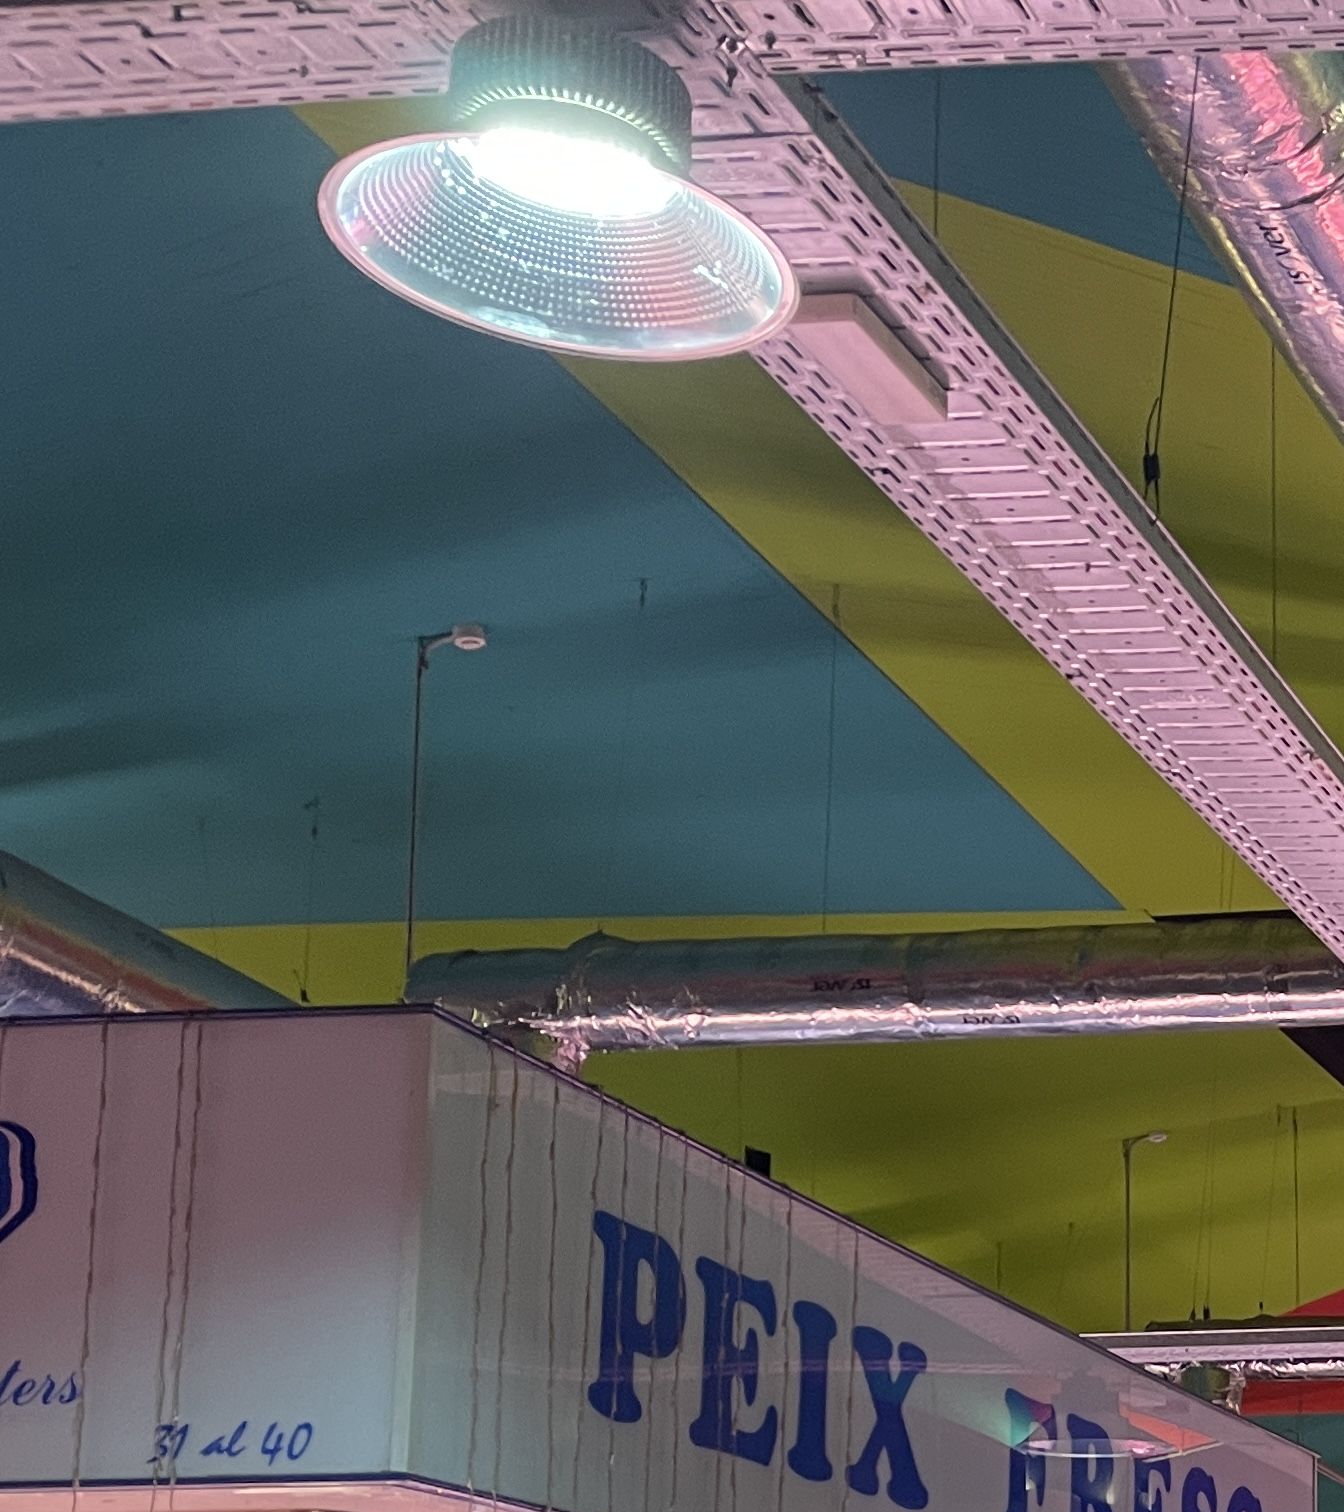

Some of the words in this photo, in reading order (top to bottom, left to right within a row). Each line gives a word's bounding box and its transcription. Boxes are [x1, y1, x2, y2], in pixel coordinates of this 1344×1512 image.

[199, 1421, 248, 1456] al
[260, 1421, 313, 1466] 40
[588, 1210, 929, 1510] PEIX
